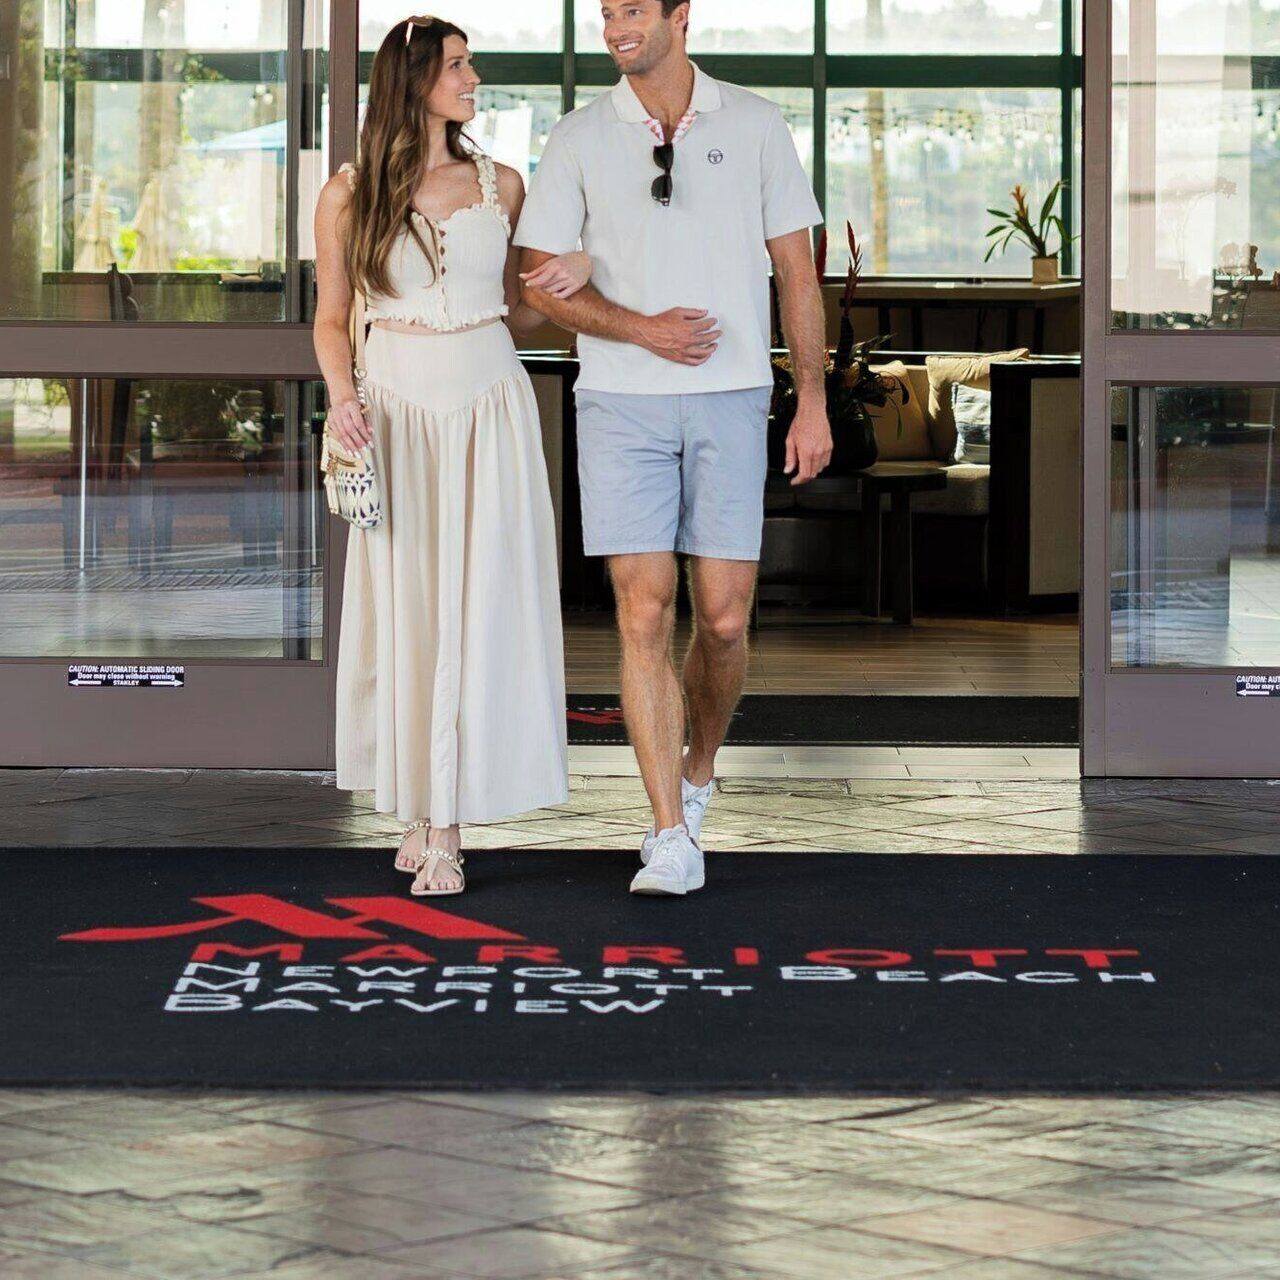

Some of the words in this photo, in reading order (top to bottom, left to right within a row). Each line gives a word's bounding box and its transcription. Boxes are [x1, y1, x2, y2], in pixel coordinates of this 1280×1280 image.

[68, 665, 99, 673] CAUTION:
[100, 665, 138, 673] AUTOMATIC
[150, 673, 175, 681] warning
[1236, 675, 1267, 683] CAUTION:
[190, 942, 1140, 968] MARRIOTT
[183, 962, 724, 980] NEWPORT
[780, 966, 1156, 983] BEACH
[174, 977, 753, 996] MARRIOTT
[164, 994, 665, 1012] BAYVIEW
